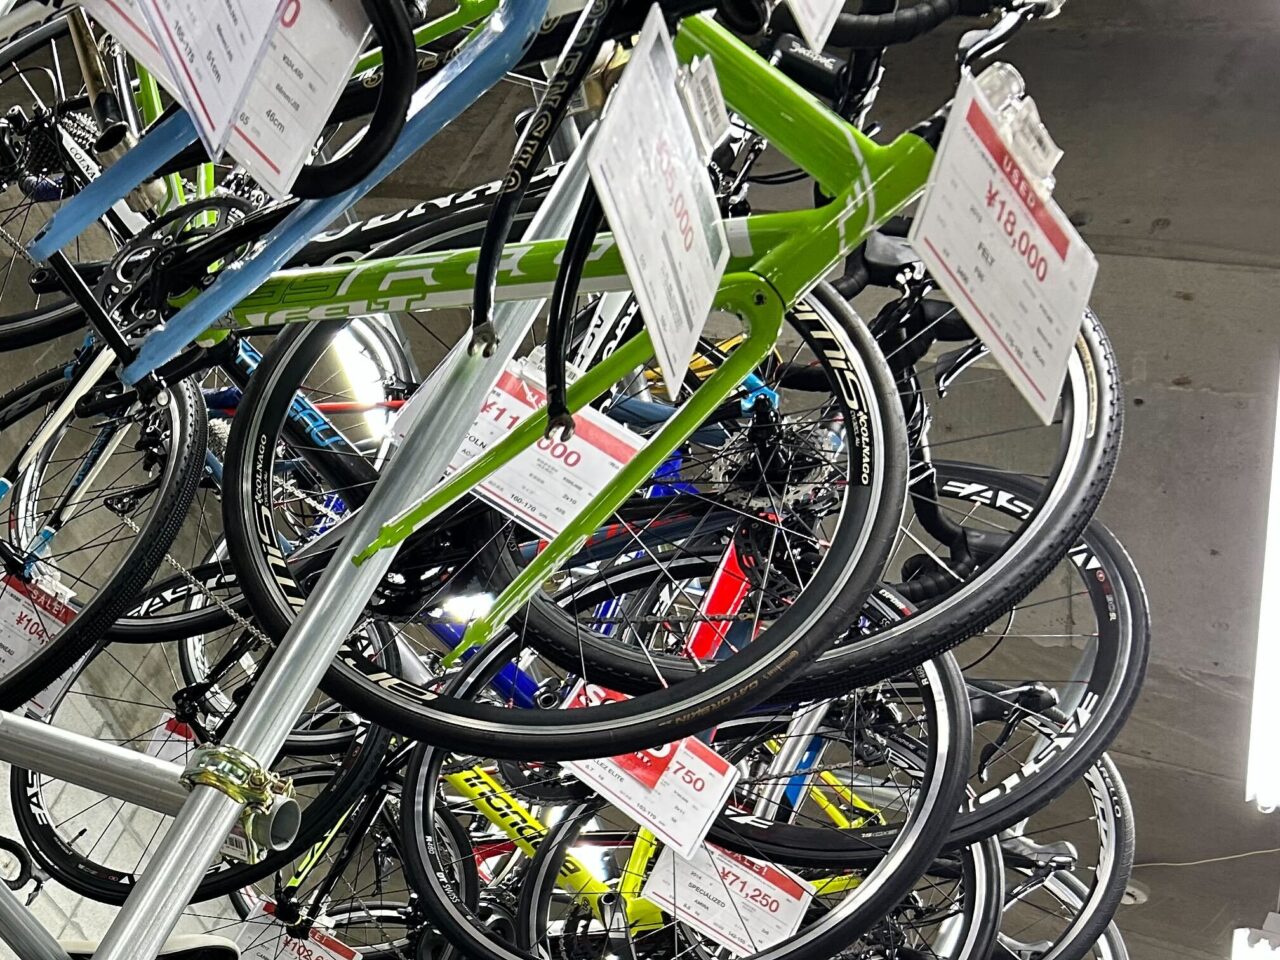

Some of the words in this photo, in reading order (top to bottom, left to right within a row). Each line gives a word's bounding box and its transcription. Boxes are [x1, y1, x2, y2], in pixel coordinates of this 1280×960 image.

[206, 50, 222, 83] 51cm
[266, 108, 285, 133] 46cm
[1002, 155, 1037, 208] USED
[985, 181, 1048, 283] ¥18,000
[977, 241, 995, 268] FELT
[254, 432, 268, 493] COLNAGO
[859, 413, 870, 485] COLNAGO
[510, 493, 537, 513] 160-170
[31, 590, 66, 617] SALE!
[442, 881, 461, 904] SWISS
[687, 882, 726, 908] SPECIALIZED
[693, 899, 709, 910] AMIRA
[716, 867, 783, 916] ¥71,250
